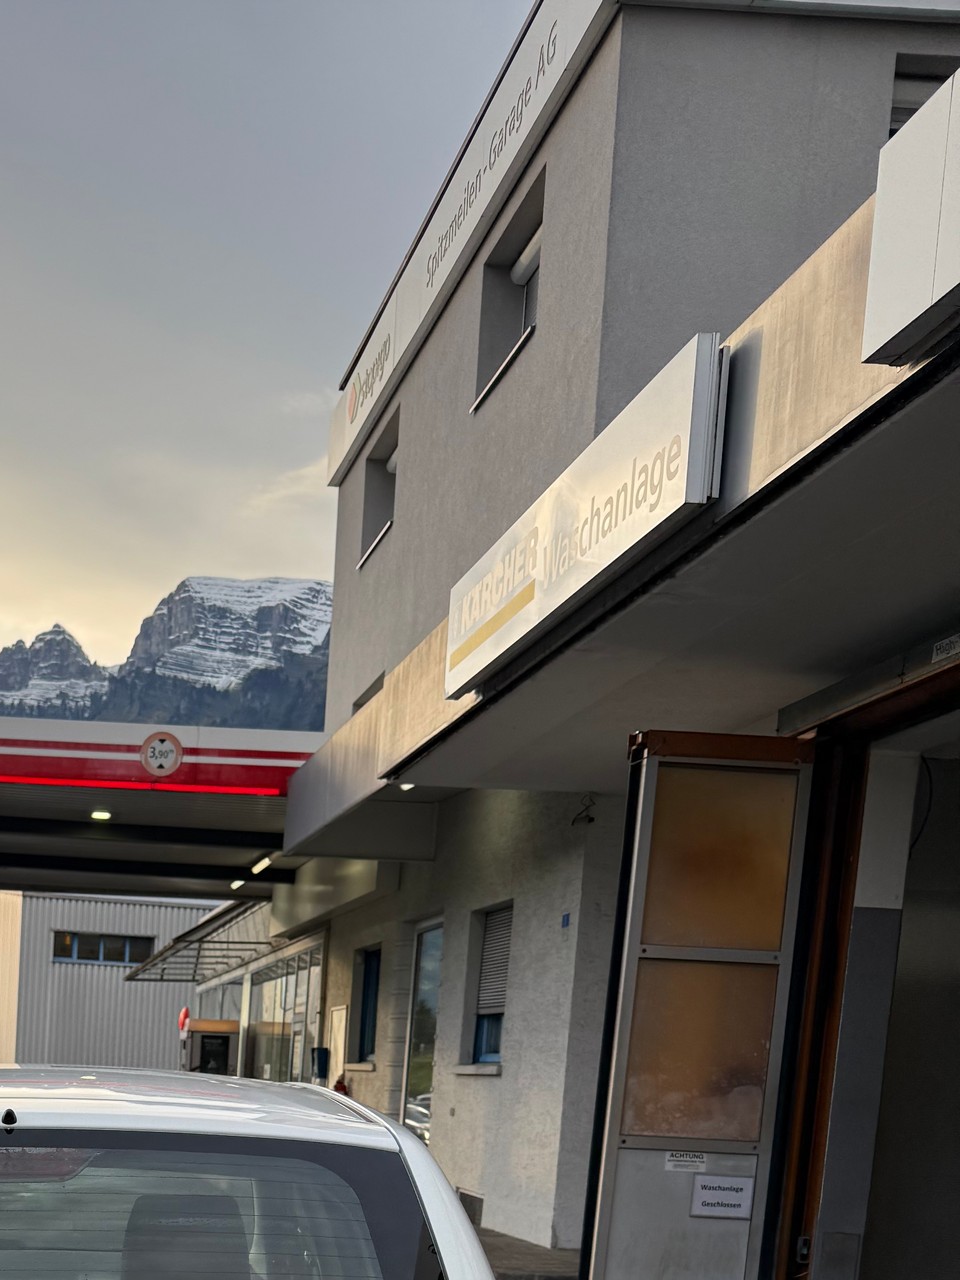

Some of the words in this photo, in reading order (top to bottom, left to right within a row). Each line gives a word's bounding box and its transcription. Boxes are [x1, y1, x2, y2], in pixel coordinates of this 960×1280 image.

[535, 19, 558, 91] AG
[542, 433, 682, 590] Waschanlage
[669, 1152, 704, 1160] ACHTUNG
[700, 1184, 744, 1193] Waschanlage
[701, 1200, 742, 1209] Geschlossen
